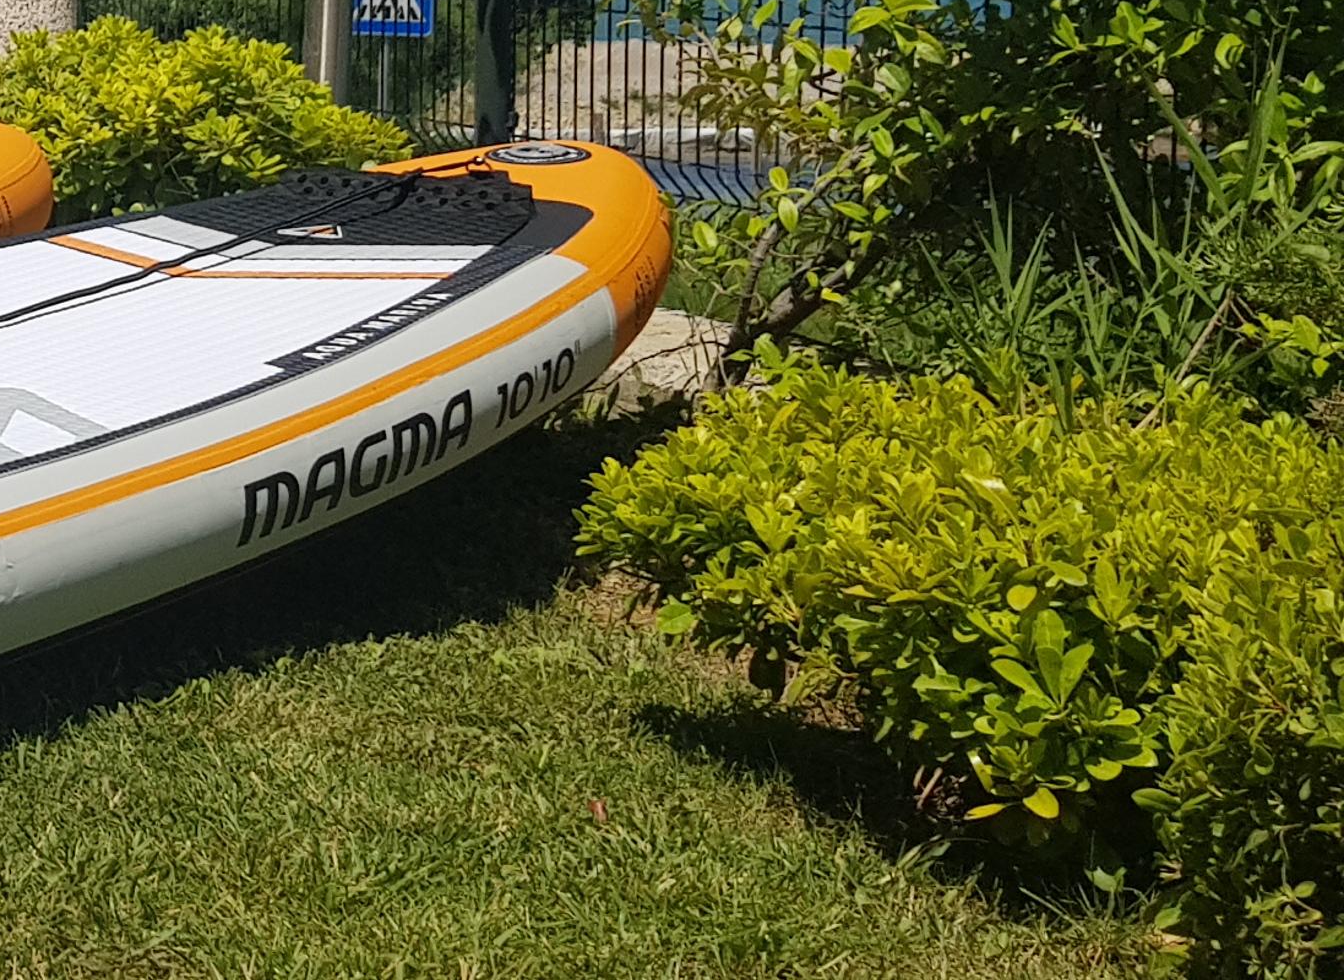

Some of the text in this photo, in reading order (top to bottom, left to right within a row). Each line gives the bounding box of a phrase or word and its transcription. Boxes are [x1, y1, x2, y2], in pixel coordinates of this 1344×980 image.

[302, 293, 454, 360] AQUA MARINA
[236, 389, 473, 548] MAGMA
